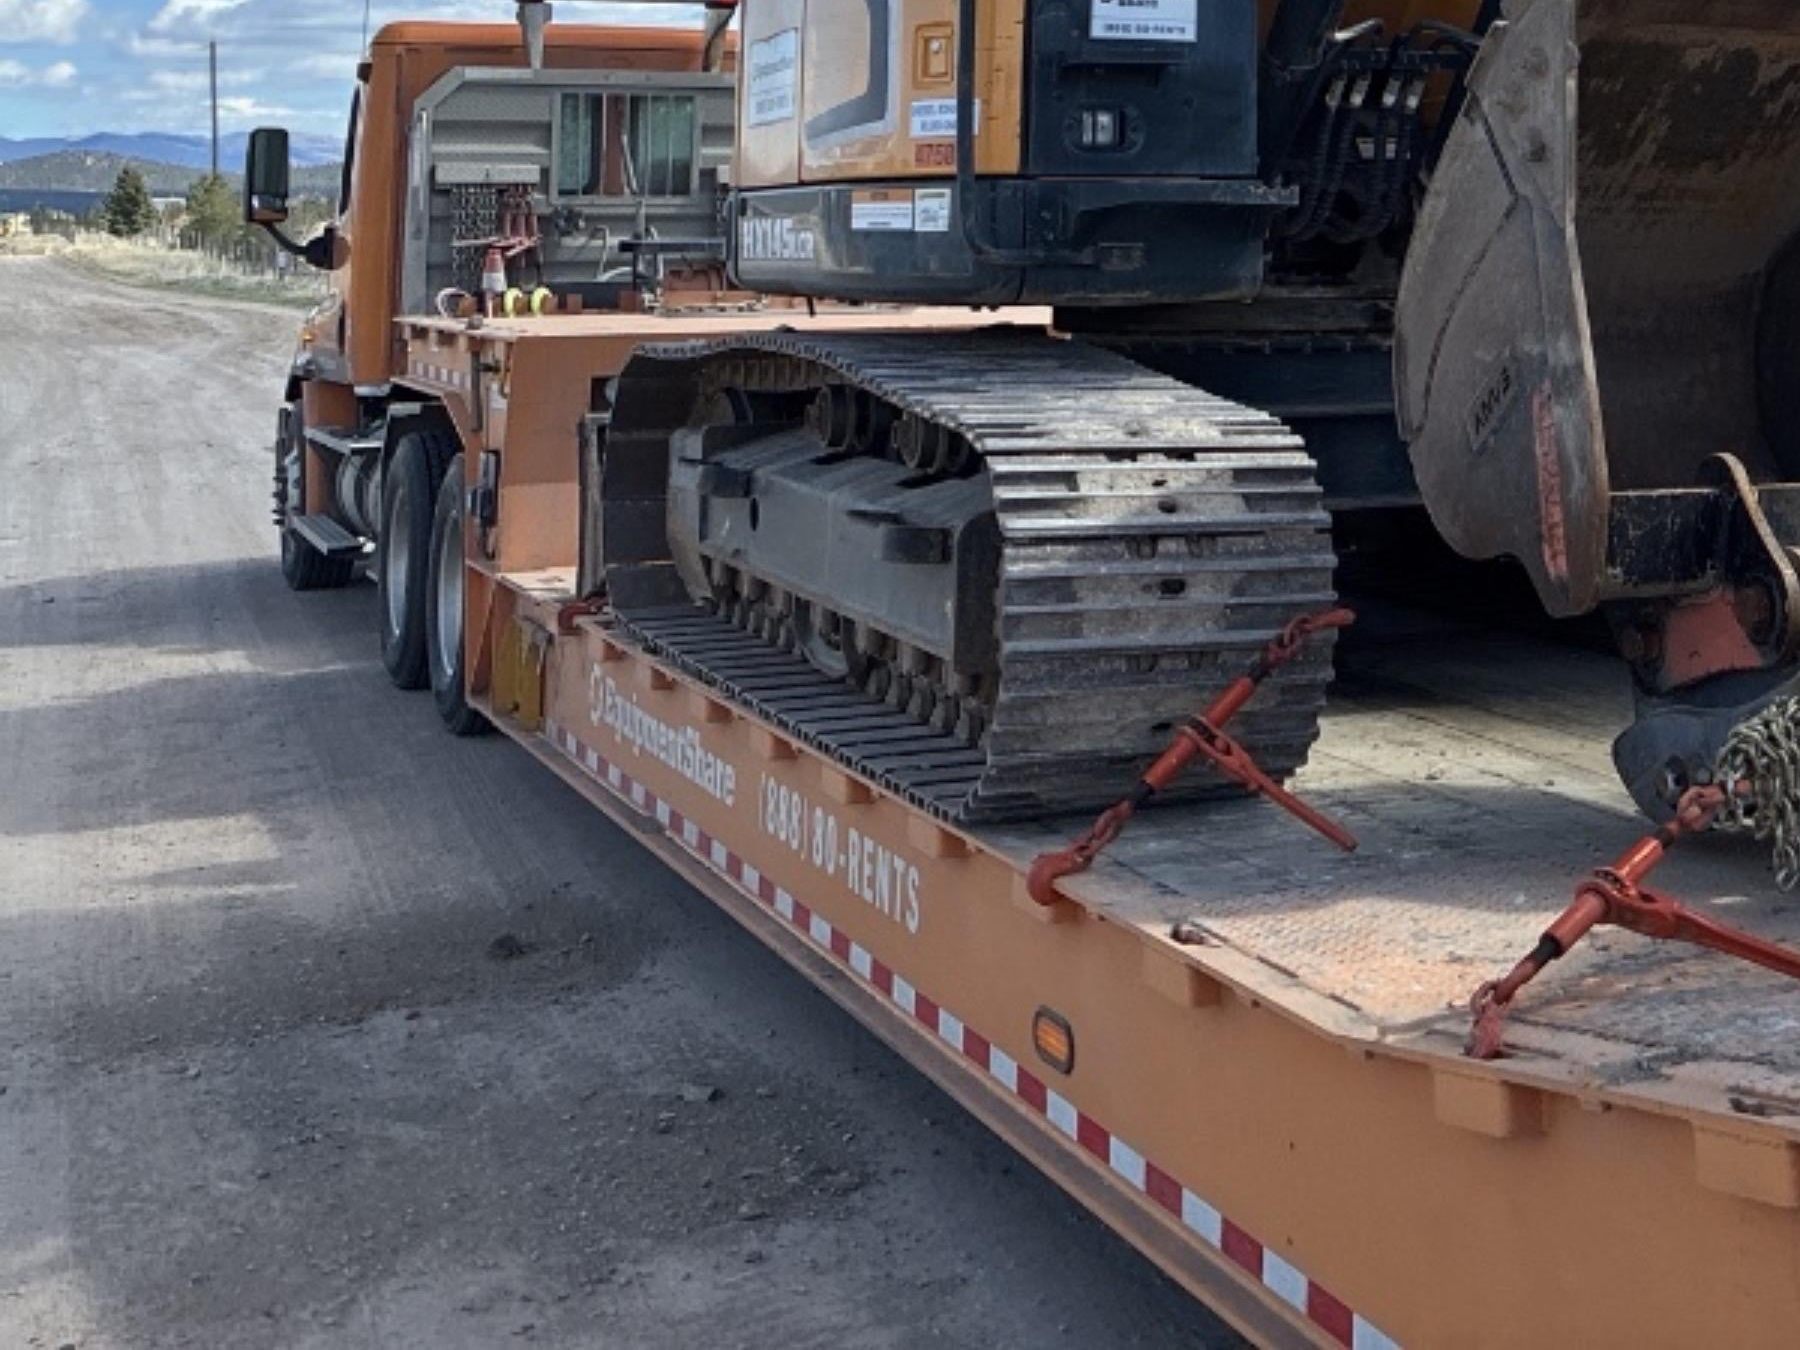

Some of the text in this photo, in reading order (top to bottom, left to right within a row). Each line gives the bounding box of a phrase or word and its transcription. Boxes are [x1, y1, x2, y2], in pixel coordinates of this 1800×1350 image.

[603, 676, 920, 934] EquipmentShare (888) 80-RENTS
